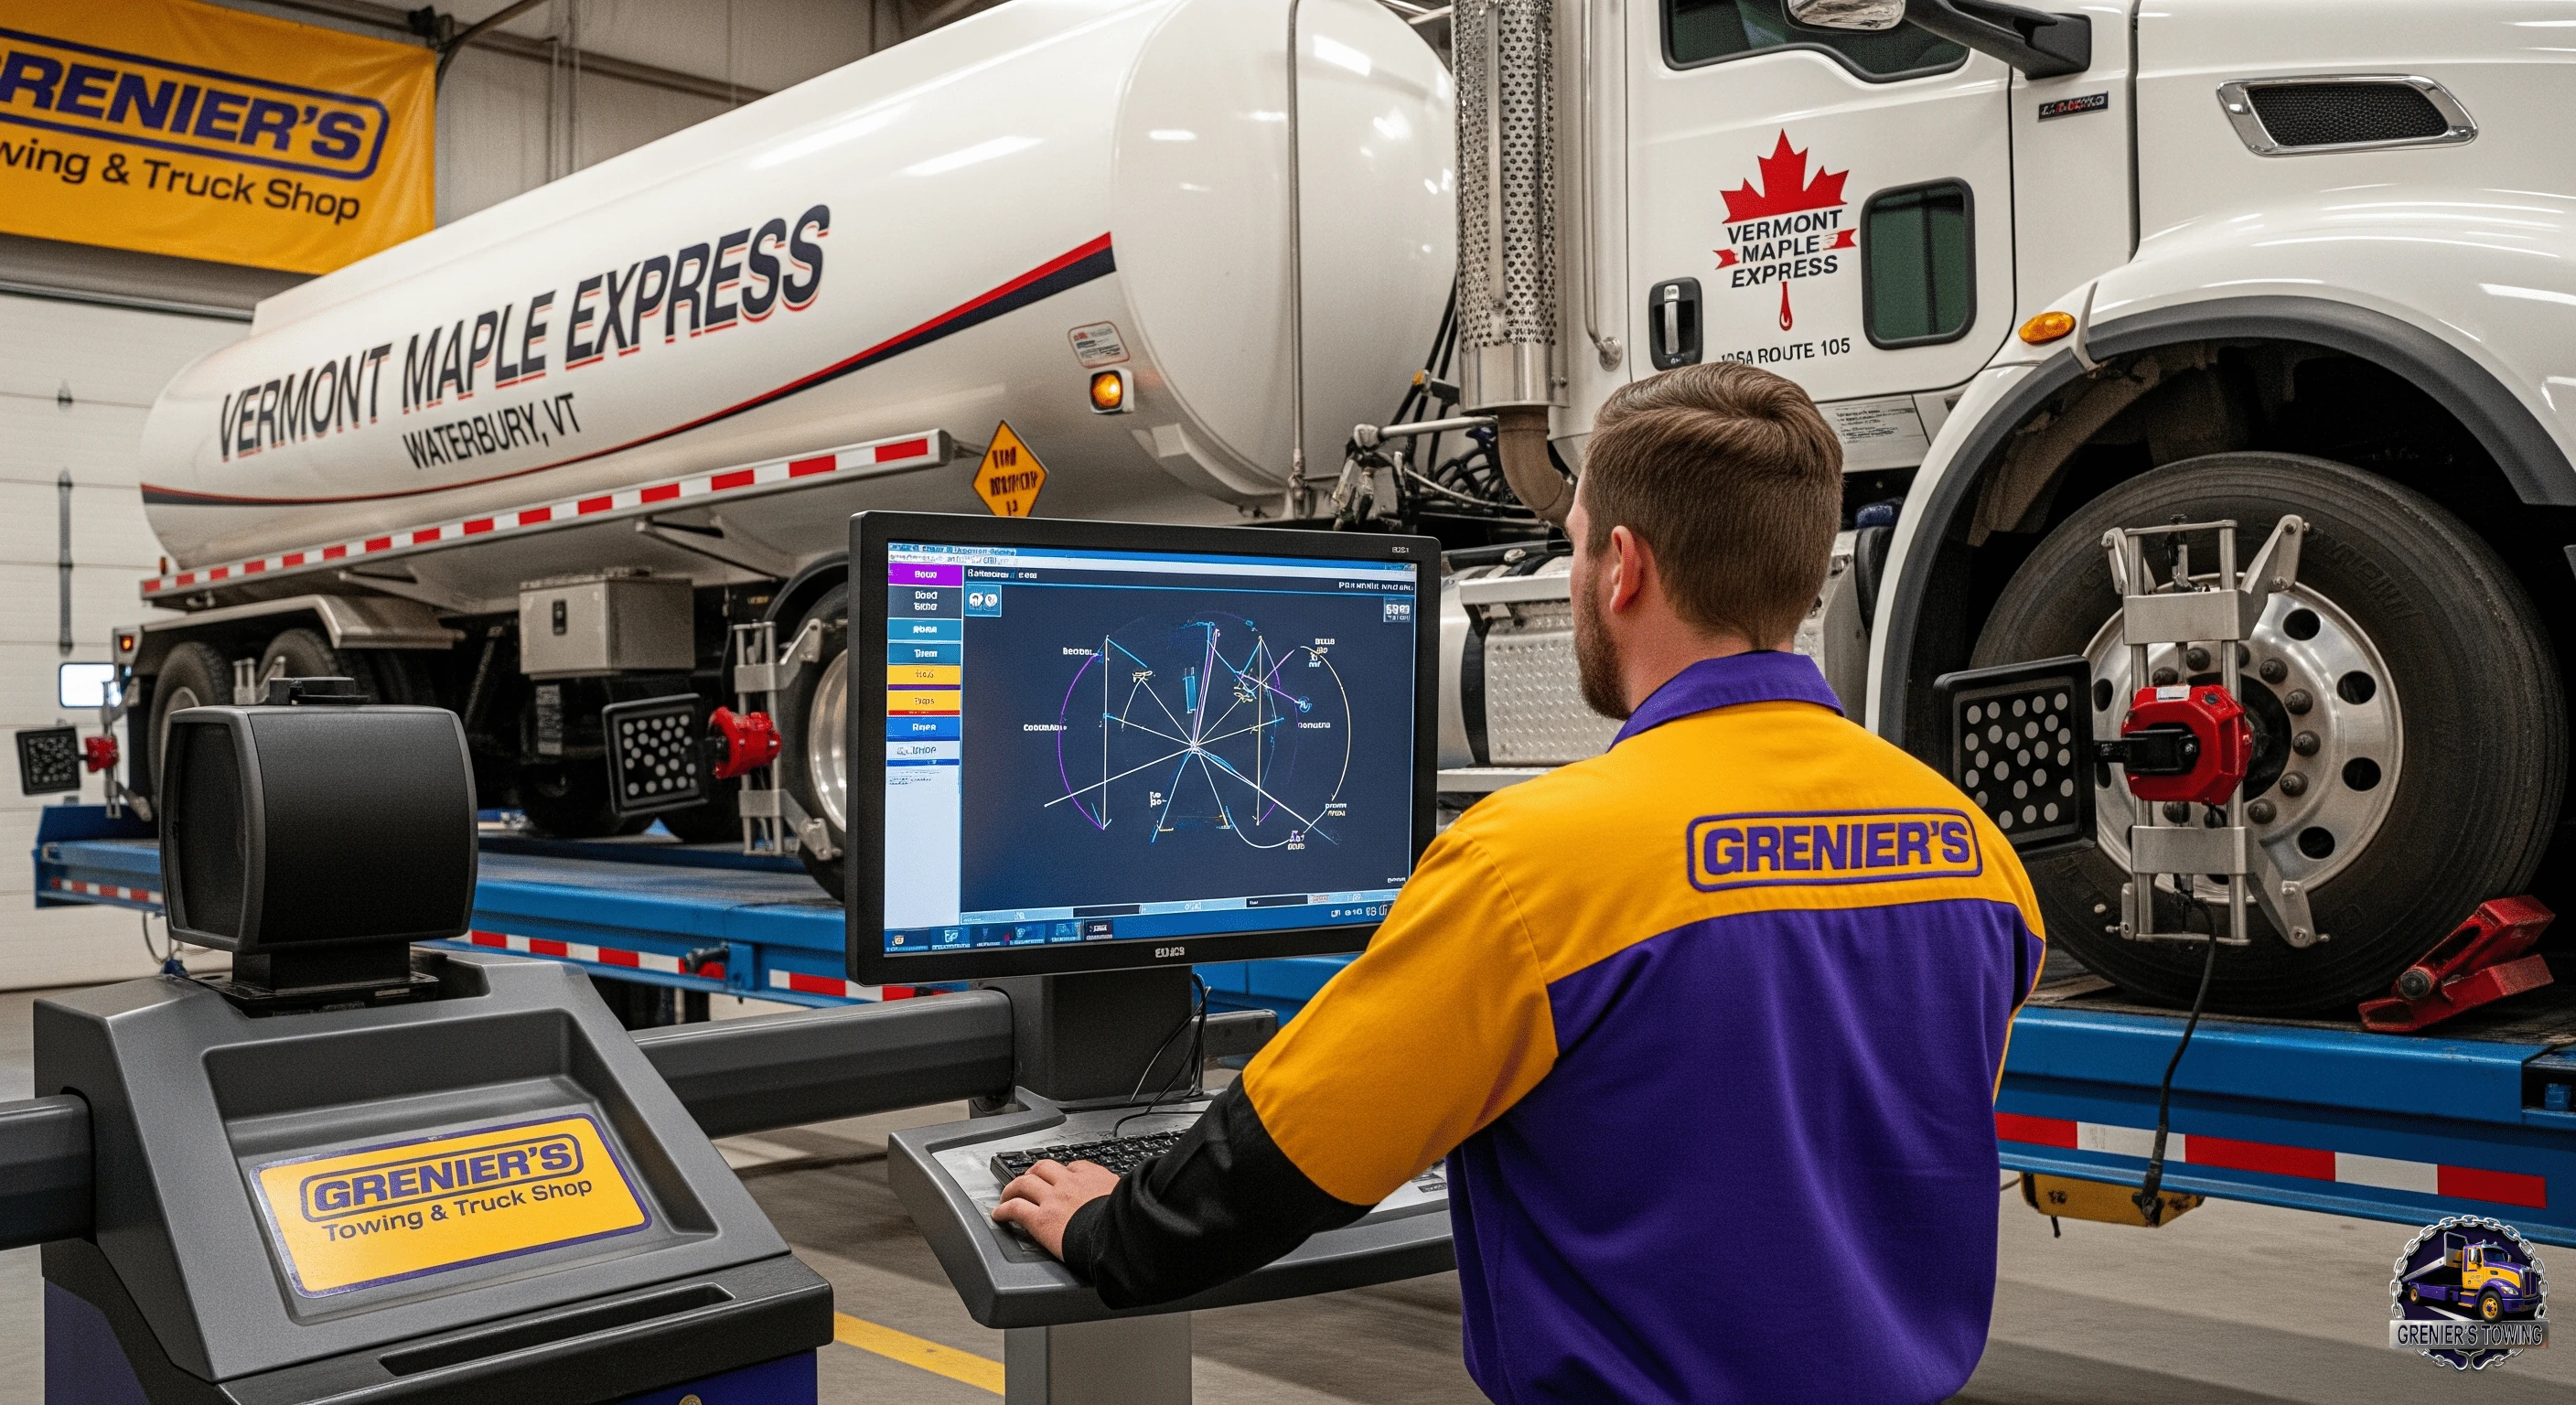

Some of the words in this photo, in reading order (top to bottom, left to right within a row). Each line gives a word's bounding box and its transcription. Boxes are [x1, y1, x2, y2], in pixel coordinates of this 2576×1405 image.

[0, 50, 367, 161] RENIER'S
[102, 153, 130, 185] &
[144, 159, 257, 205] Truck
[264, 177, 360, 225] Shop
[1726, 209, 1843, 245] VERMONT
[1742, 235, 1820, 264] MAPLE
[1731, 254, 1839, 289] EXPRESS
[220, 342, 393, 461] VERMONT
[402, 289, 557, 415] MAPLE
[564, 203, 831, 371] EXPRESS
[1757, 342, 1816, 364] ROUTE
[1820, 337, 1851, 357] 105
[402, 402, 551, 470] WATERBURY,
[546, 392, 582, 439] VT
[1703, 820, 1970, 876] GRENIER'S
[314, 1142, 574, 1213] GRENIER'S
[322, 1207, 424, 1242] Towing
[430, 1205, 449, 1223] &
[454, 1189, 528, 1217] Truck
[532, 1178, 593, 1202] Shop
